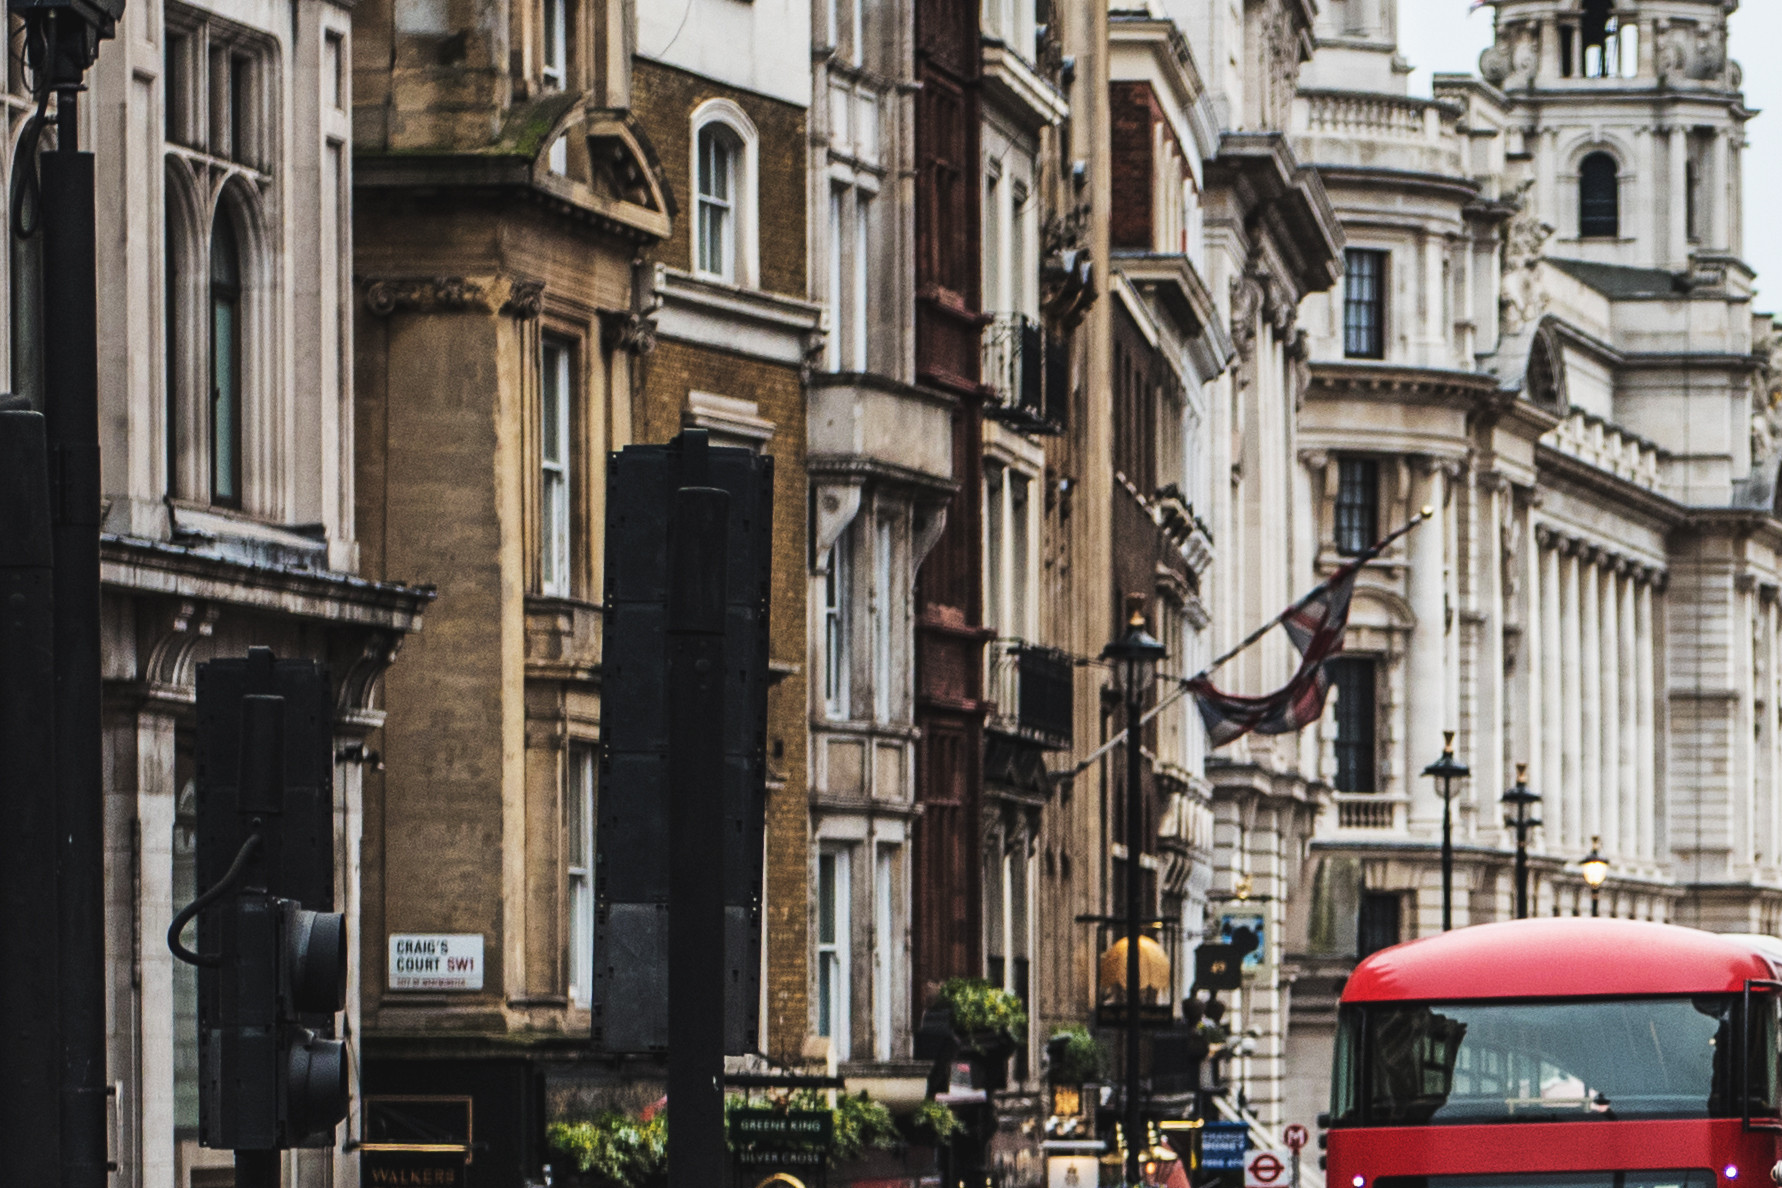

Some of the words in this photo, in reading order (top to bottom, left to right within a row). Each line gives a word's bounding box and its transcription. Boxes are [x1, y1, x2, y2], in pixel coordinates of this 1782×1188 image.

[396, 939, 449, 956] CRAIG'S
[396, 956, 440, 973] COURT
[447, 956, 475, 973] SW1
[740, 1119, 786, 1132] GREENE
[790, 1119, 822, 1132] KING
[740, 1153, 778, 1164] SILVER
[782, 1153, 820, 1164] CROSS
[371, 1168, 455, 1184] WALKERS
